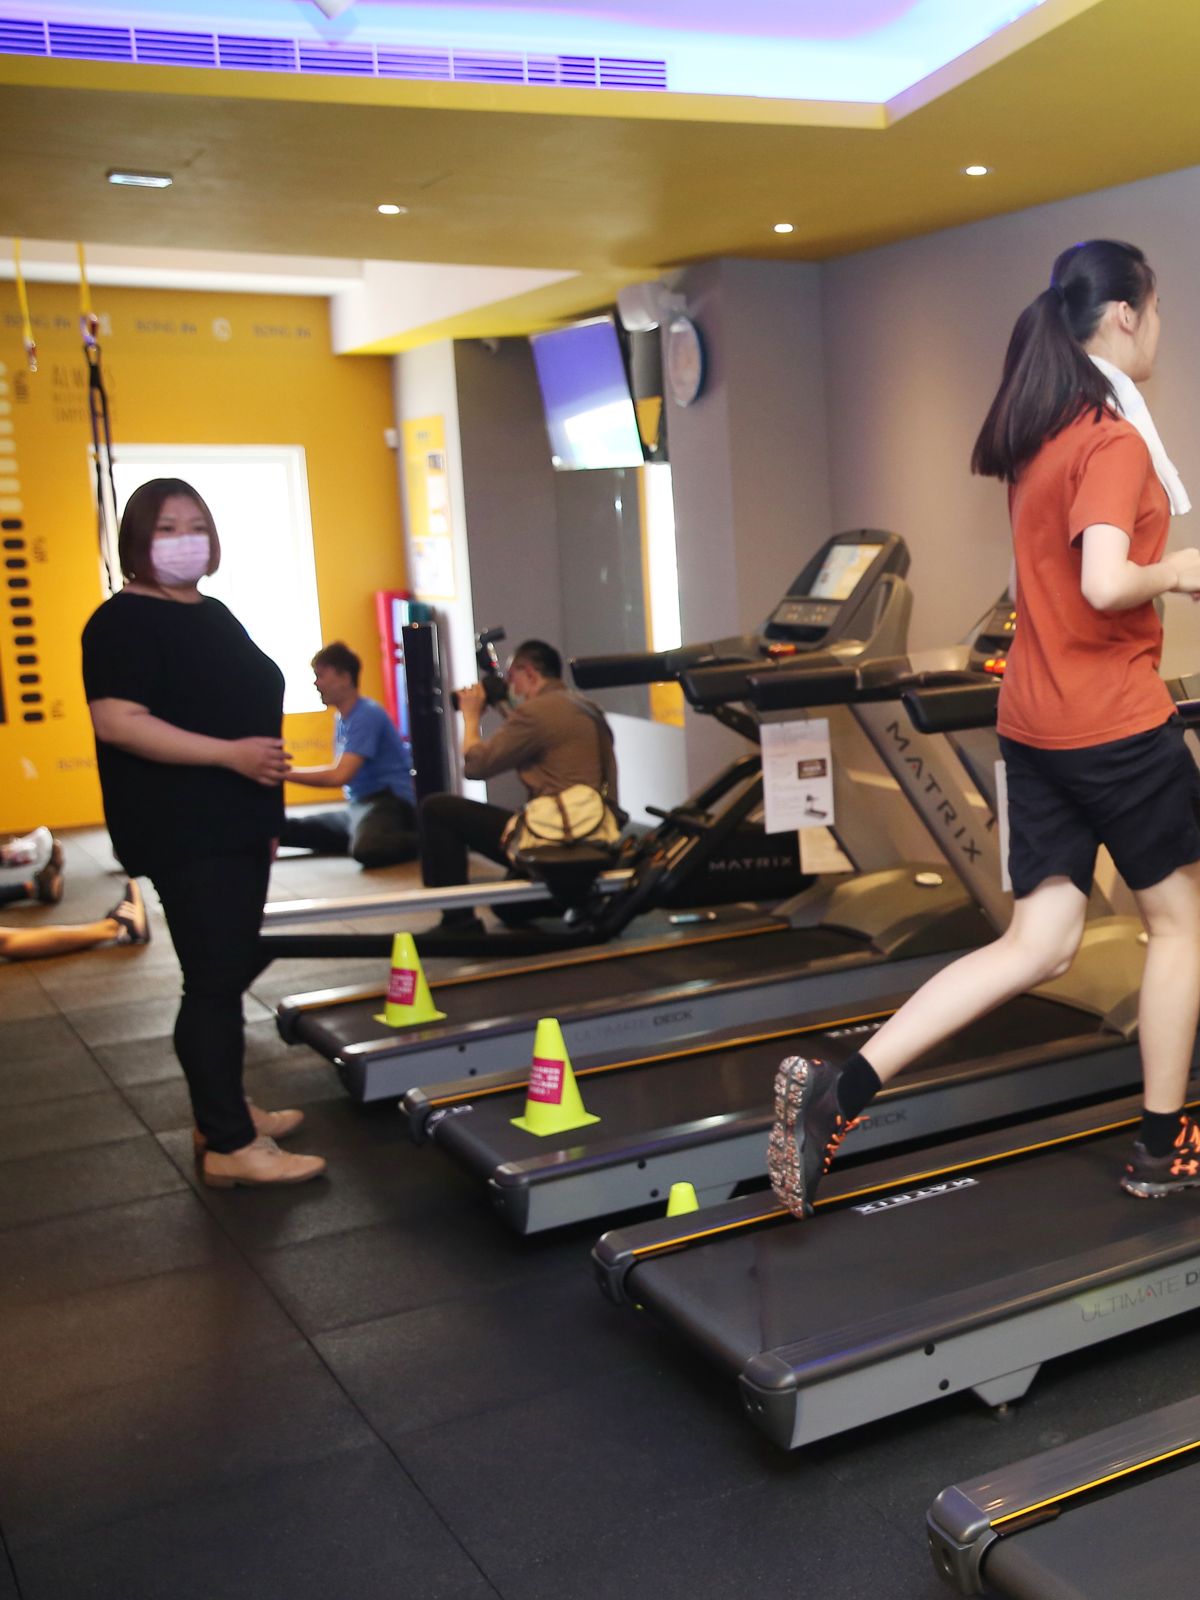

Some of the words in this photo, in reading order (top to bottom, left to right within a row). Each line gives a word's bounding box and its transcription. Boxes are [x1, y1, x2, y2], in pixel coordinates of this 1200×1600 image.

[886, 721, 983, 864] MATRIX
[708, 854, 794, 872] MATRIX
[1080, 1274, 1183, 1323] ULTIMATE
